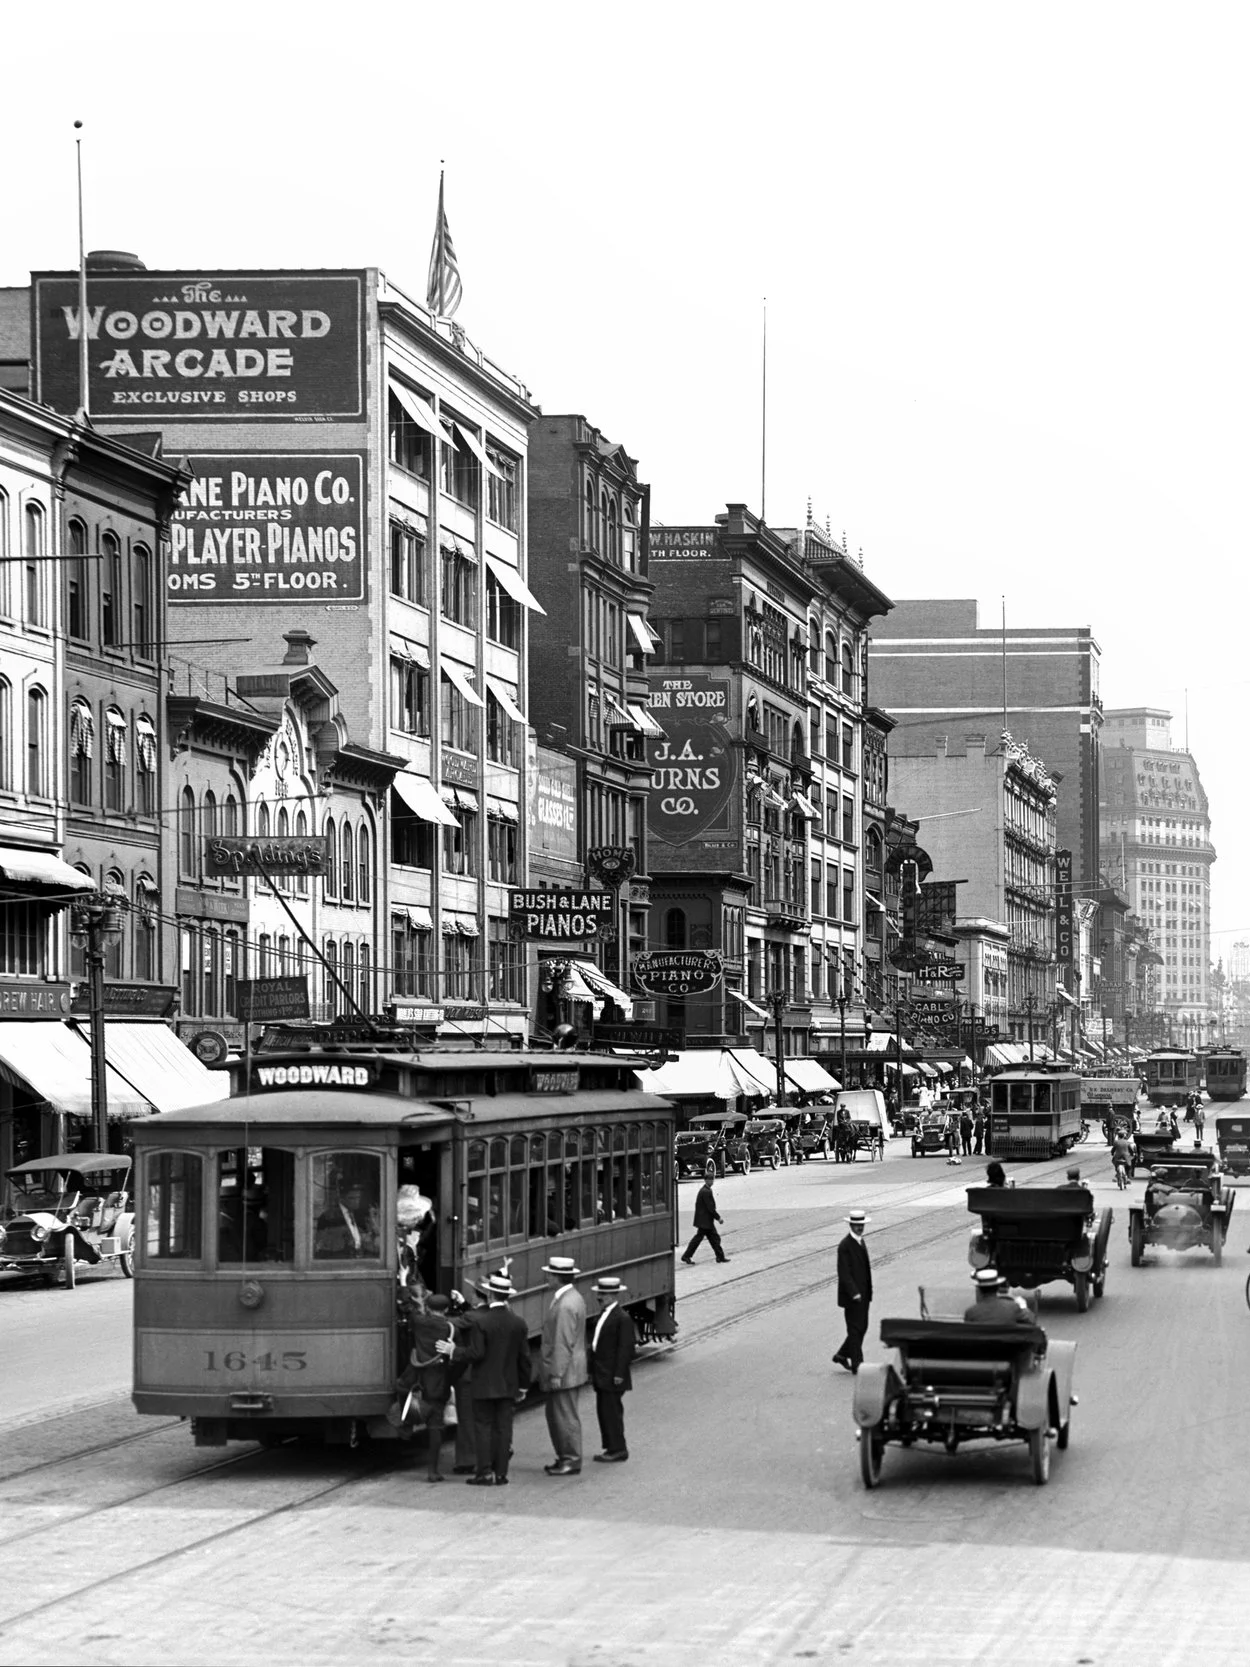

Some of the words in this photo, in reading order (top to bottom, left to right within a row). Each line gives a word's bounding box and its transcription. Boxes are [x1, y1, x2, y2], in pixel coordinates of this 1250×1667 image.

[182, 282, 221, 303] The
[61, 305, 331, 340] WOODWARD
[99, 348, 294, 378] ARCADE
[113, 391, 226, 404] EXCLUSIVE
[238, 390, 297, 403] SHOPS
[231, 471, 309, 507] PIANO
[314, 470, 355, 505] CO.
[669, 549, 712, 557] FLOOR.
[663, 680, 693, 691] THE
[676, 691, 726, 708] STORE
[660, 796, 699, 815] CO.
[592, 849, 629, 861] HOME
[527, 913, 597, 936] PIANOS
[639, 955, 718, 972] MANUFACTURERS
[650, 970, 704, 982] PIANO
[253, 982, 292, 993] ROYAL
[668, 983, 689, 993] CO
[269, 992, 306, 1006] PARLORS
[342, 1016, 390, 1024] VICOR
[258, 1065, 369, 1087] WOODWARD
[202, 1351, 307, 1371] 1645
